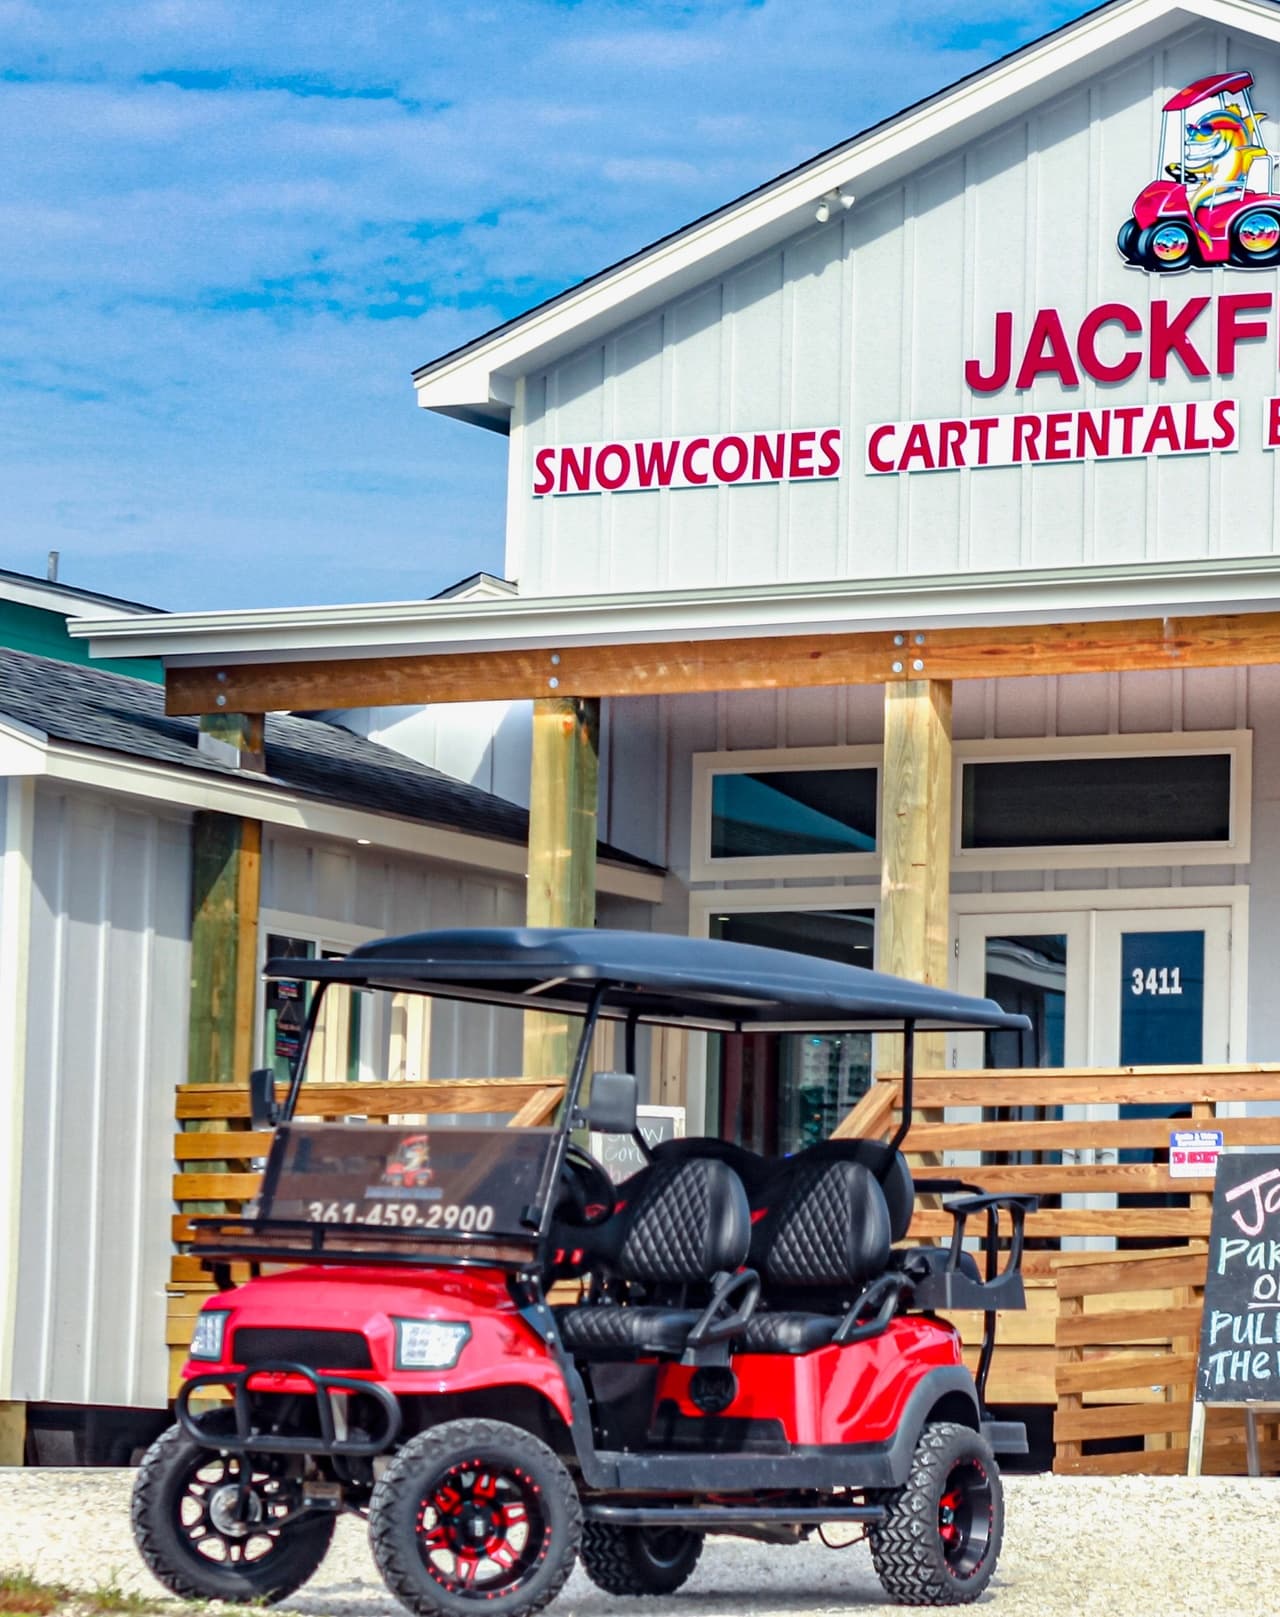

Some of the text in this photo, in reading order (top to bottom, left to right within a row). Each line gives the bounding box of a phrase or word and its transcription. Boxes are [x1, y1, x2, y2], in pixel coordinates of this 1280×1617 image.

[868, 400, 1235, 473] CART RENTALS
[533, 429, 841, 494] SNOWCONES
[1131, 967, 1183, 995] 3411
[307, 1201, 495, 1231] 361-459-2900
